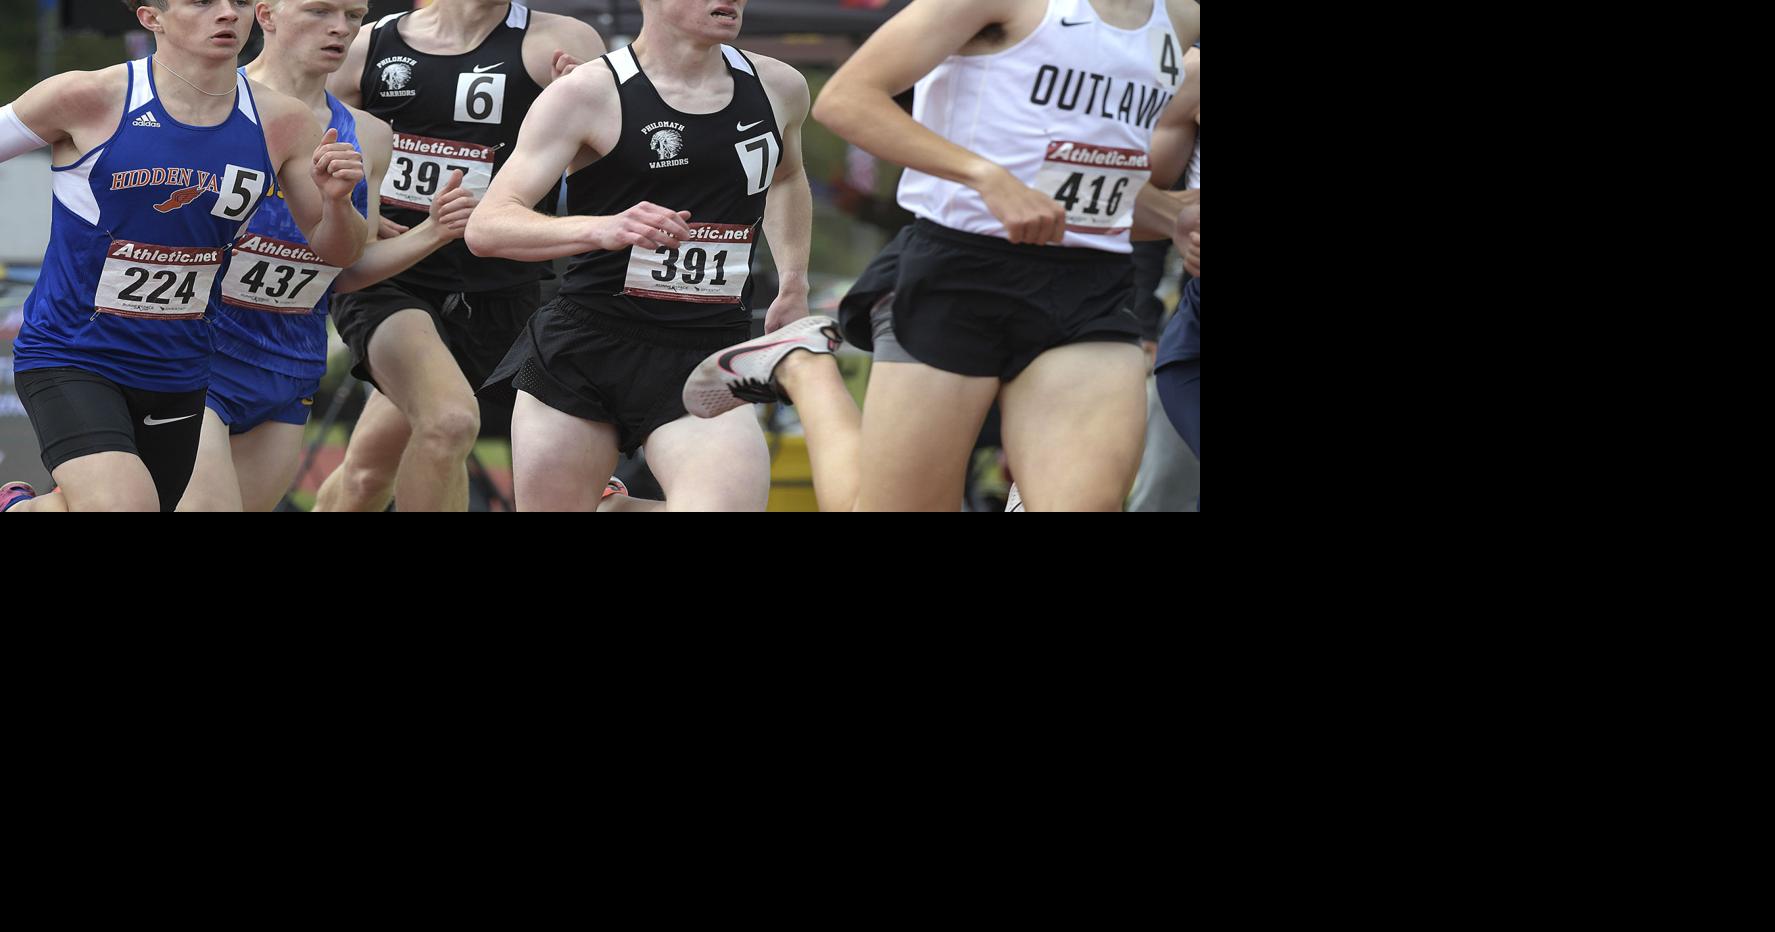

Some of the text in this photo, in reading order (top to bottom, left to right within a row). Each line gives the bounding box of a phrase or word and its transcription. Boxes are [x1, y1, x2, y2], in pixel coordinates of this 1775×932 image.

[376, 56, 417, 69] PHILOMATH
[1160, 32, 1179, 86] 4
[380, 89, 416, 97] WARRIORS
[466, 76, 494, 120] 6
[132, 119, 160, 128] adidas
[641, 121, 685, 135] PHILOMATH
[393, 133, 489, 159] Athletic.net
[1048, 143, 1148, 167] Athletic.net
[649, 158, 689, 169] WARRIORS
[744, 138, 769, 189] 7
[110, 168, 224, 194] HIDDEN VA
[223, 170, 257, 217] 5
[1054, 172, 1129, 216] 416
[660, 226, 749, 240] etic.net
[112, 243, 218, 263] Athletic.net
[239, 236, 324, 262] Athletic.
[651, 245, 728, 285] 391
[117, 267, 198, 305] 224
[240, 260, 320, 299] 437
